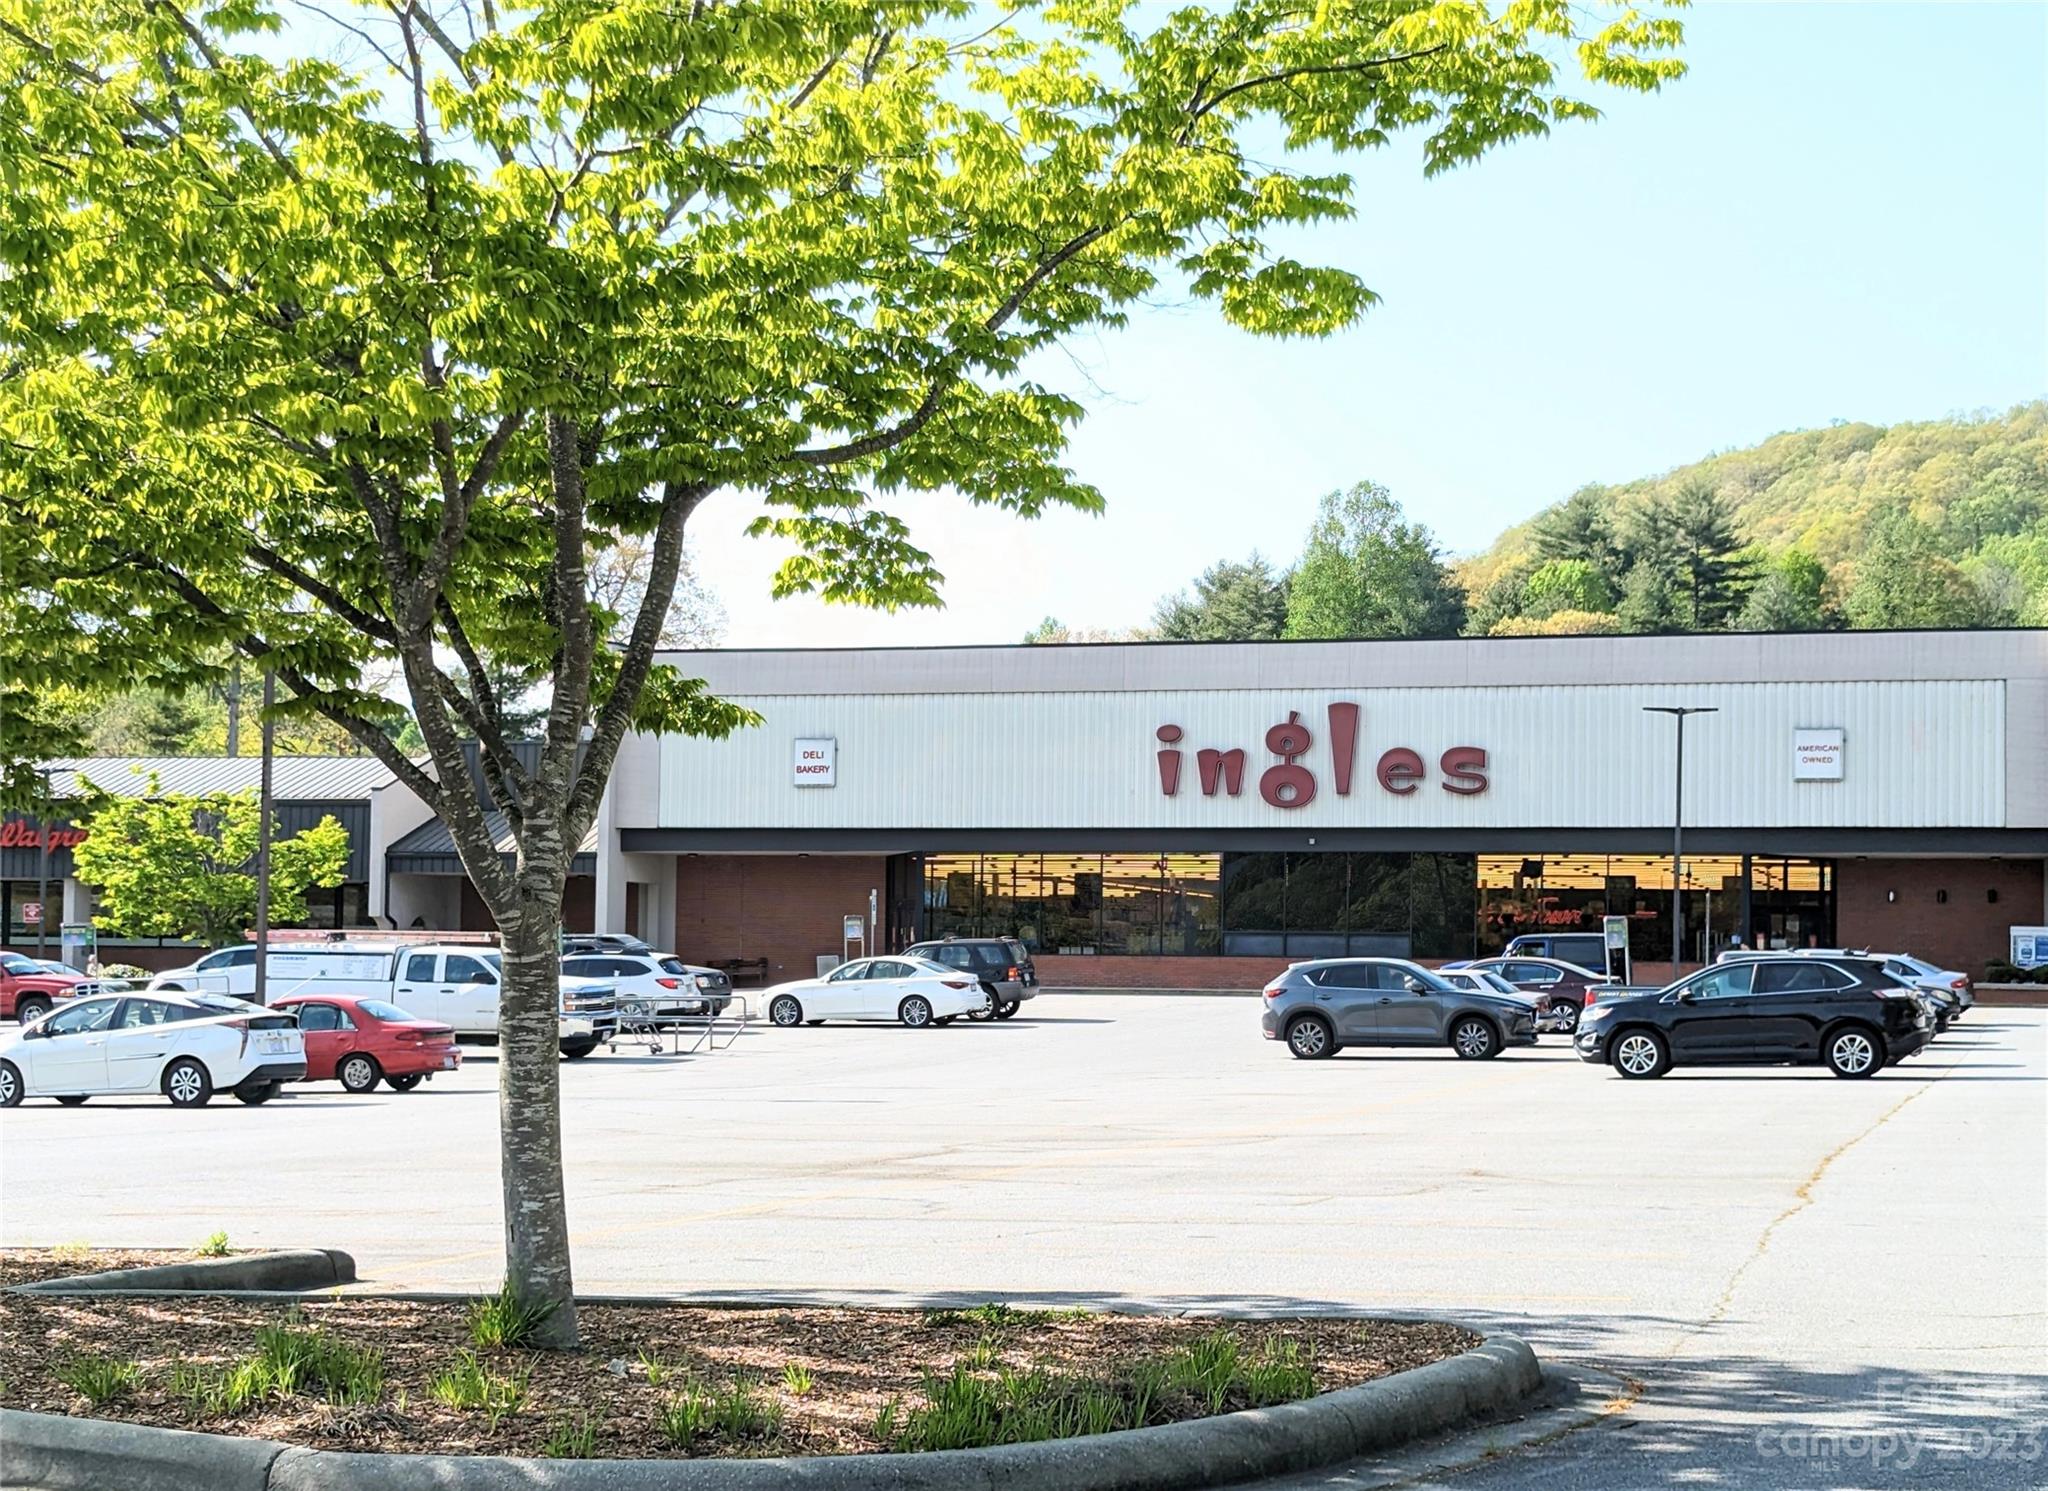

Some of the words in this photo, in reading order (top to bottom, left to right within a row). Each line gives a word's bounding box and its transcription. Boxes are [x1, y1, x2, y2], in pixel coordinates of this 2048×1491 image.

[1797, 744, 1839, 752] AMERICAN
[802, 751, 824, 759] DELI
[1156, 702, 1490, 808] ingles
[1801, 756, 1833, 764] OWNED
[796, 765, 830, 774] BAKERY
[0, 819, 88, 855] Wagre
